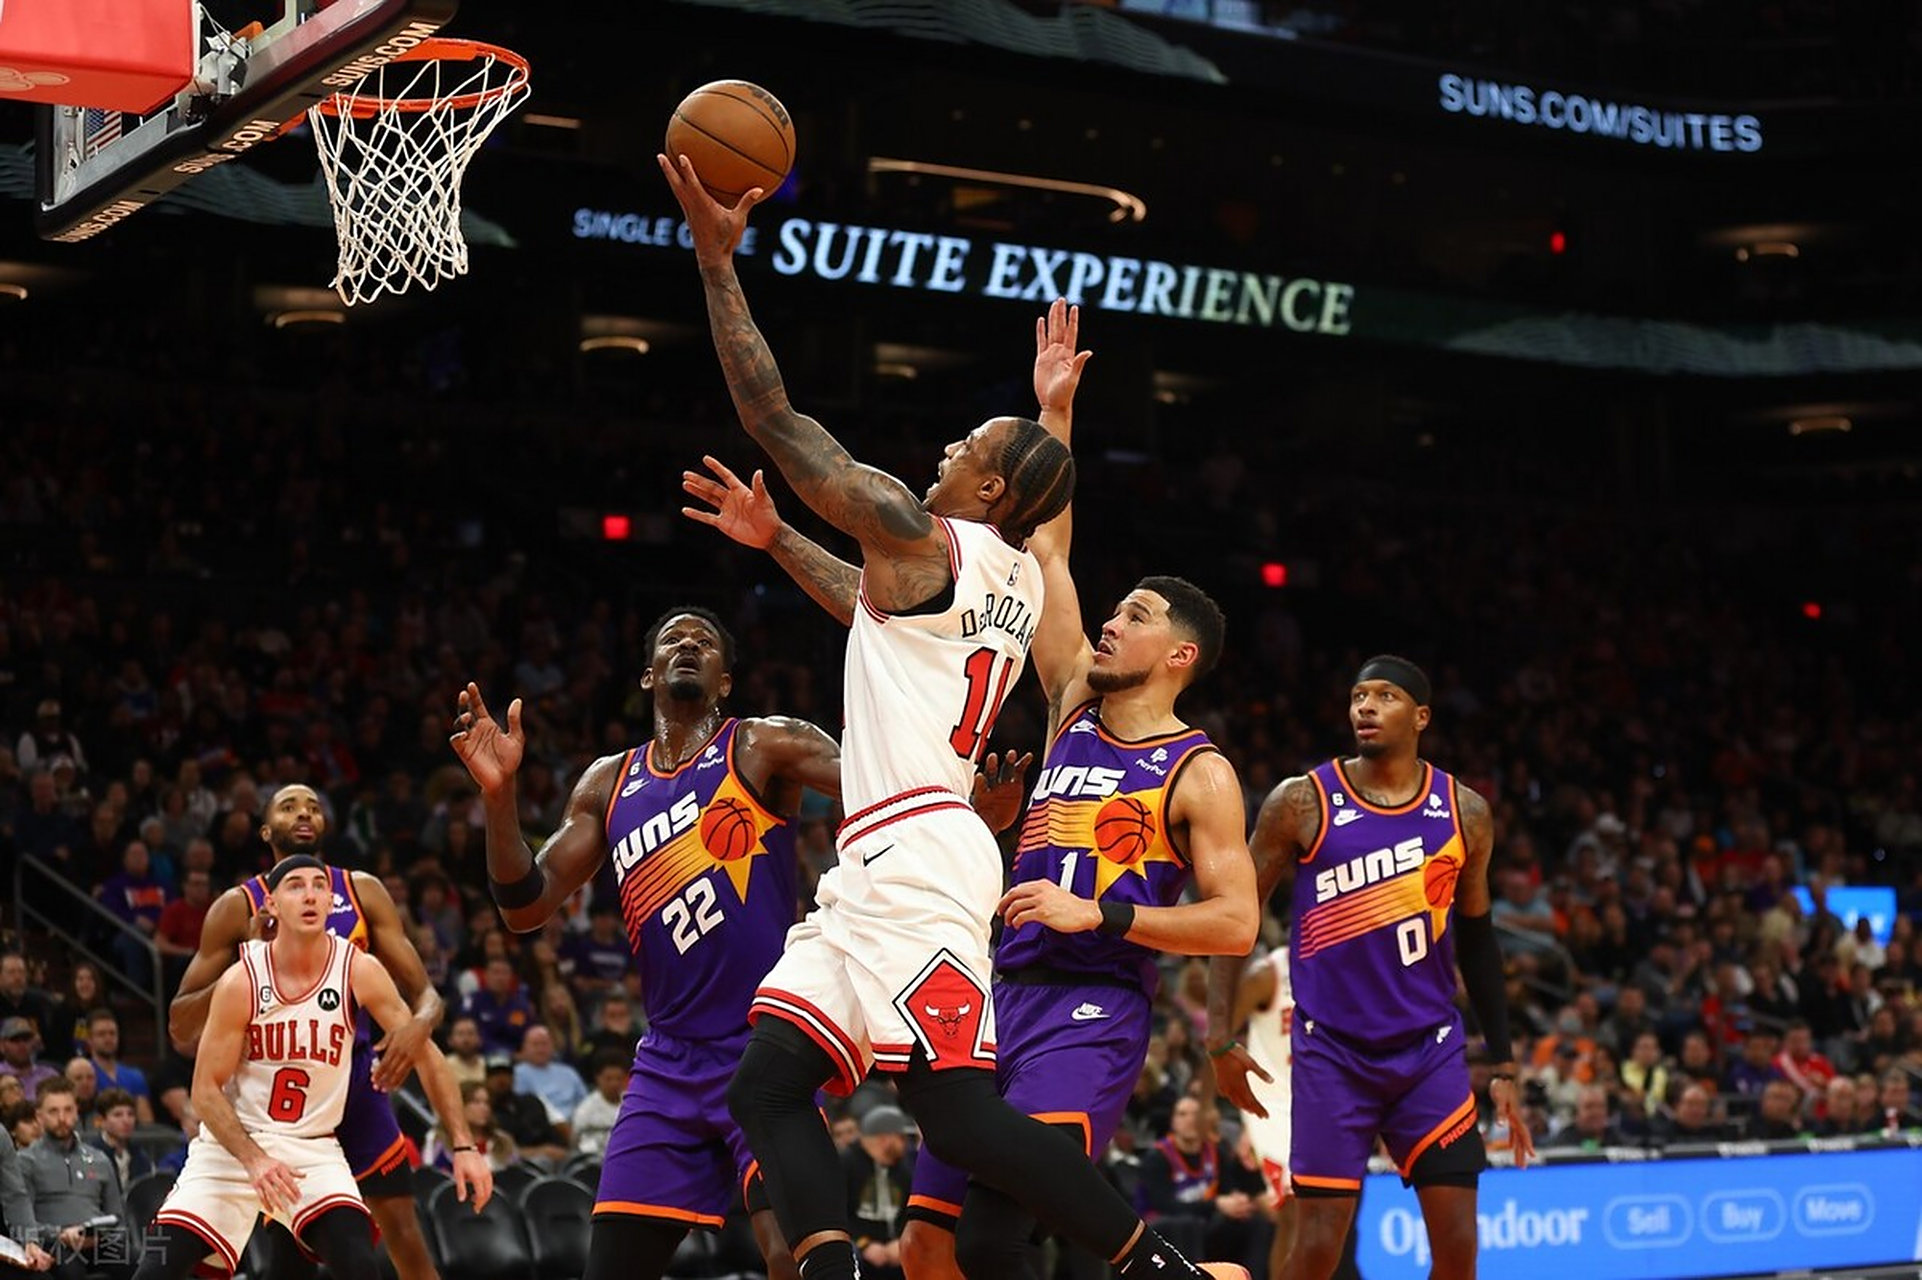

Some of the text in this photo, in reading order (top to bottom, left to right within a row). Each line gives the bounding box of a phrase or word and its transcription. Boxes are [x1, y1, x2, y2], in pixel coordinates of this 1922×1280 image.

[320, 21, 440, 87] SUNS.COM
[1438, 73, 1763, 152] SUNS.COM/SUITES
[572, 207, 1355, 336] SINGLE GE SUITE EXPERIENCE
[1135, 758, 1167, 777] PayPal
[1060, 851, 1079, 893] 1
[1315, 836, 1426, 904] SUNS
[661, 876, 725, 956] 22
[1396, 916, 1429, 968] 0
[247, 1019, 346, 1068] BULLS
[267, 1066, 311, 1124] 6
[1379, 1198, 1589, 1268] Opndoor
[1720, 1201, 1764, 1233] Buy
[1805, 1195, 1862, 1222] Move
